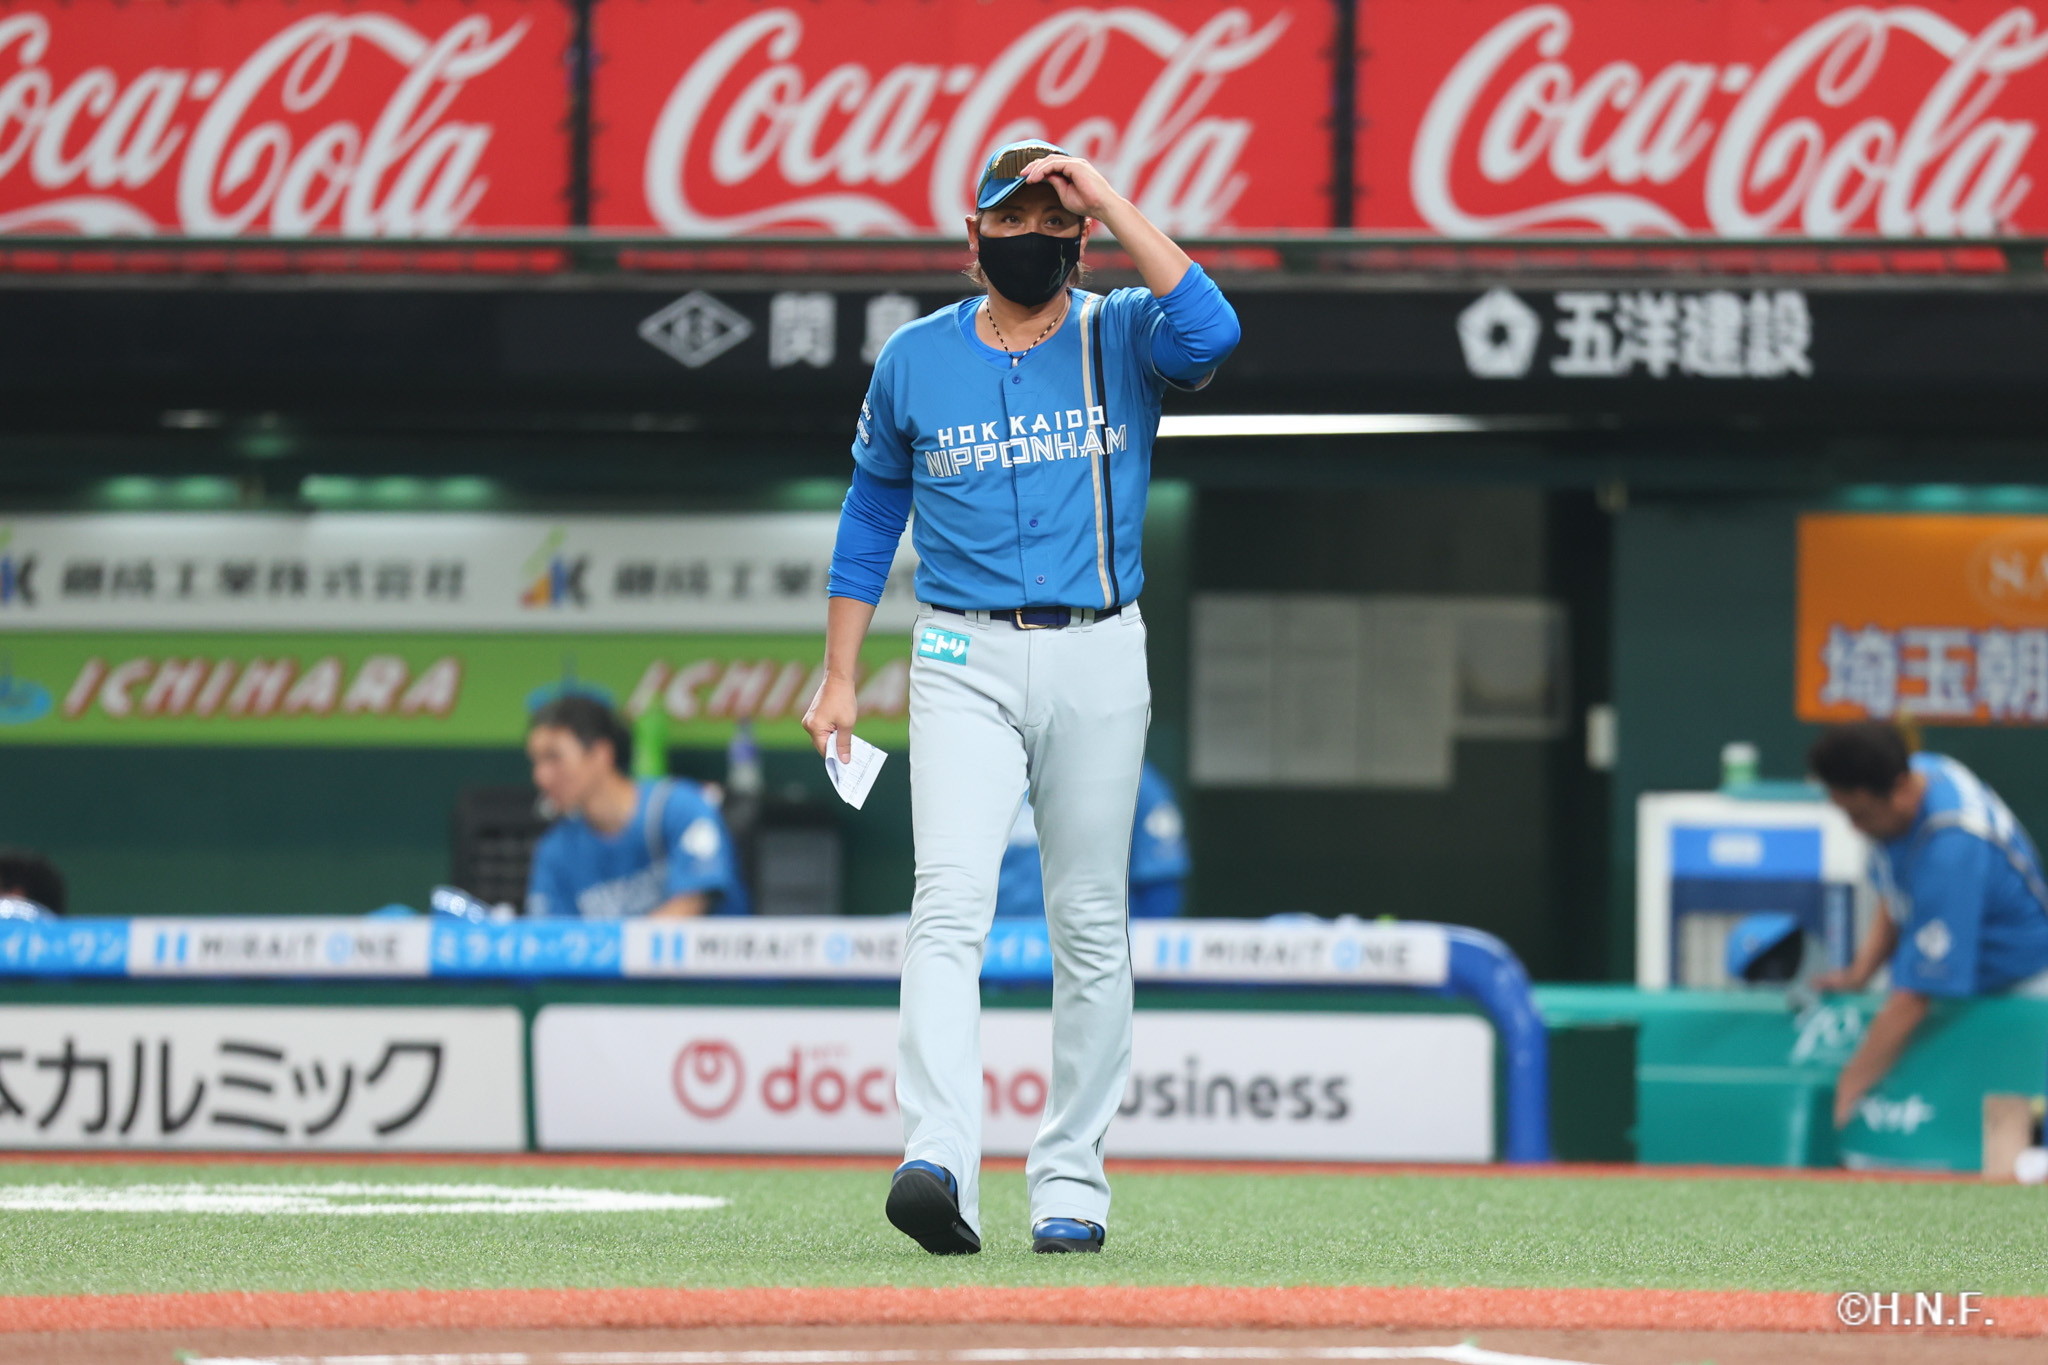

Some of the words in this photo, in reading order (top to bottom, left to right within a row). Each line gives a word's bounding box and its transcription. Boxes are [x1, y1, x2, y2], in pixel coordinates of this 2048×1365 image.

[1410, 3, 2048, 238] Coca-Cola
[1551, 291, 1814, 378] 五洋建設
[924, 423, 1128, 478] NIPPONHAM
[937, 405, 1106, 448] HOKKAIDO
[921, 632, 966, 658] ニトリ
[1818, 621, 2048, 720] 埼玉朝
[63, 654, 464, 720] ICHIHARA
[1112, 1054, 1353, 1121] usiness
